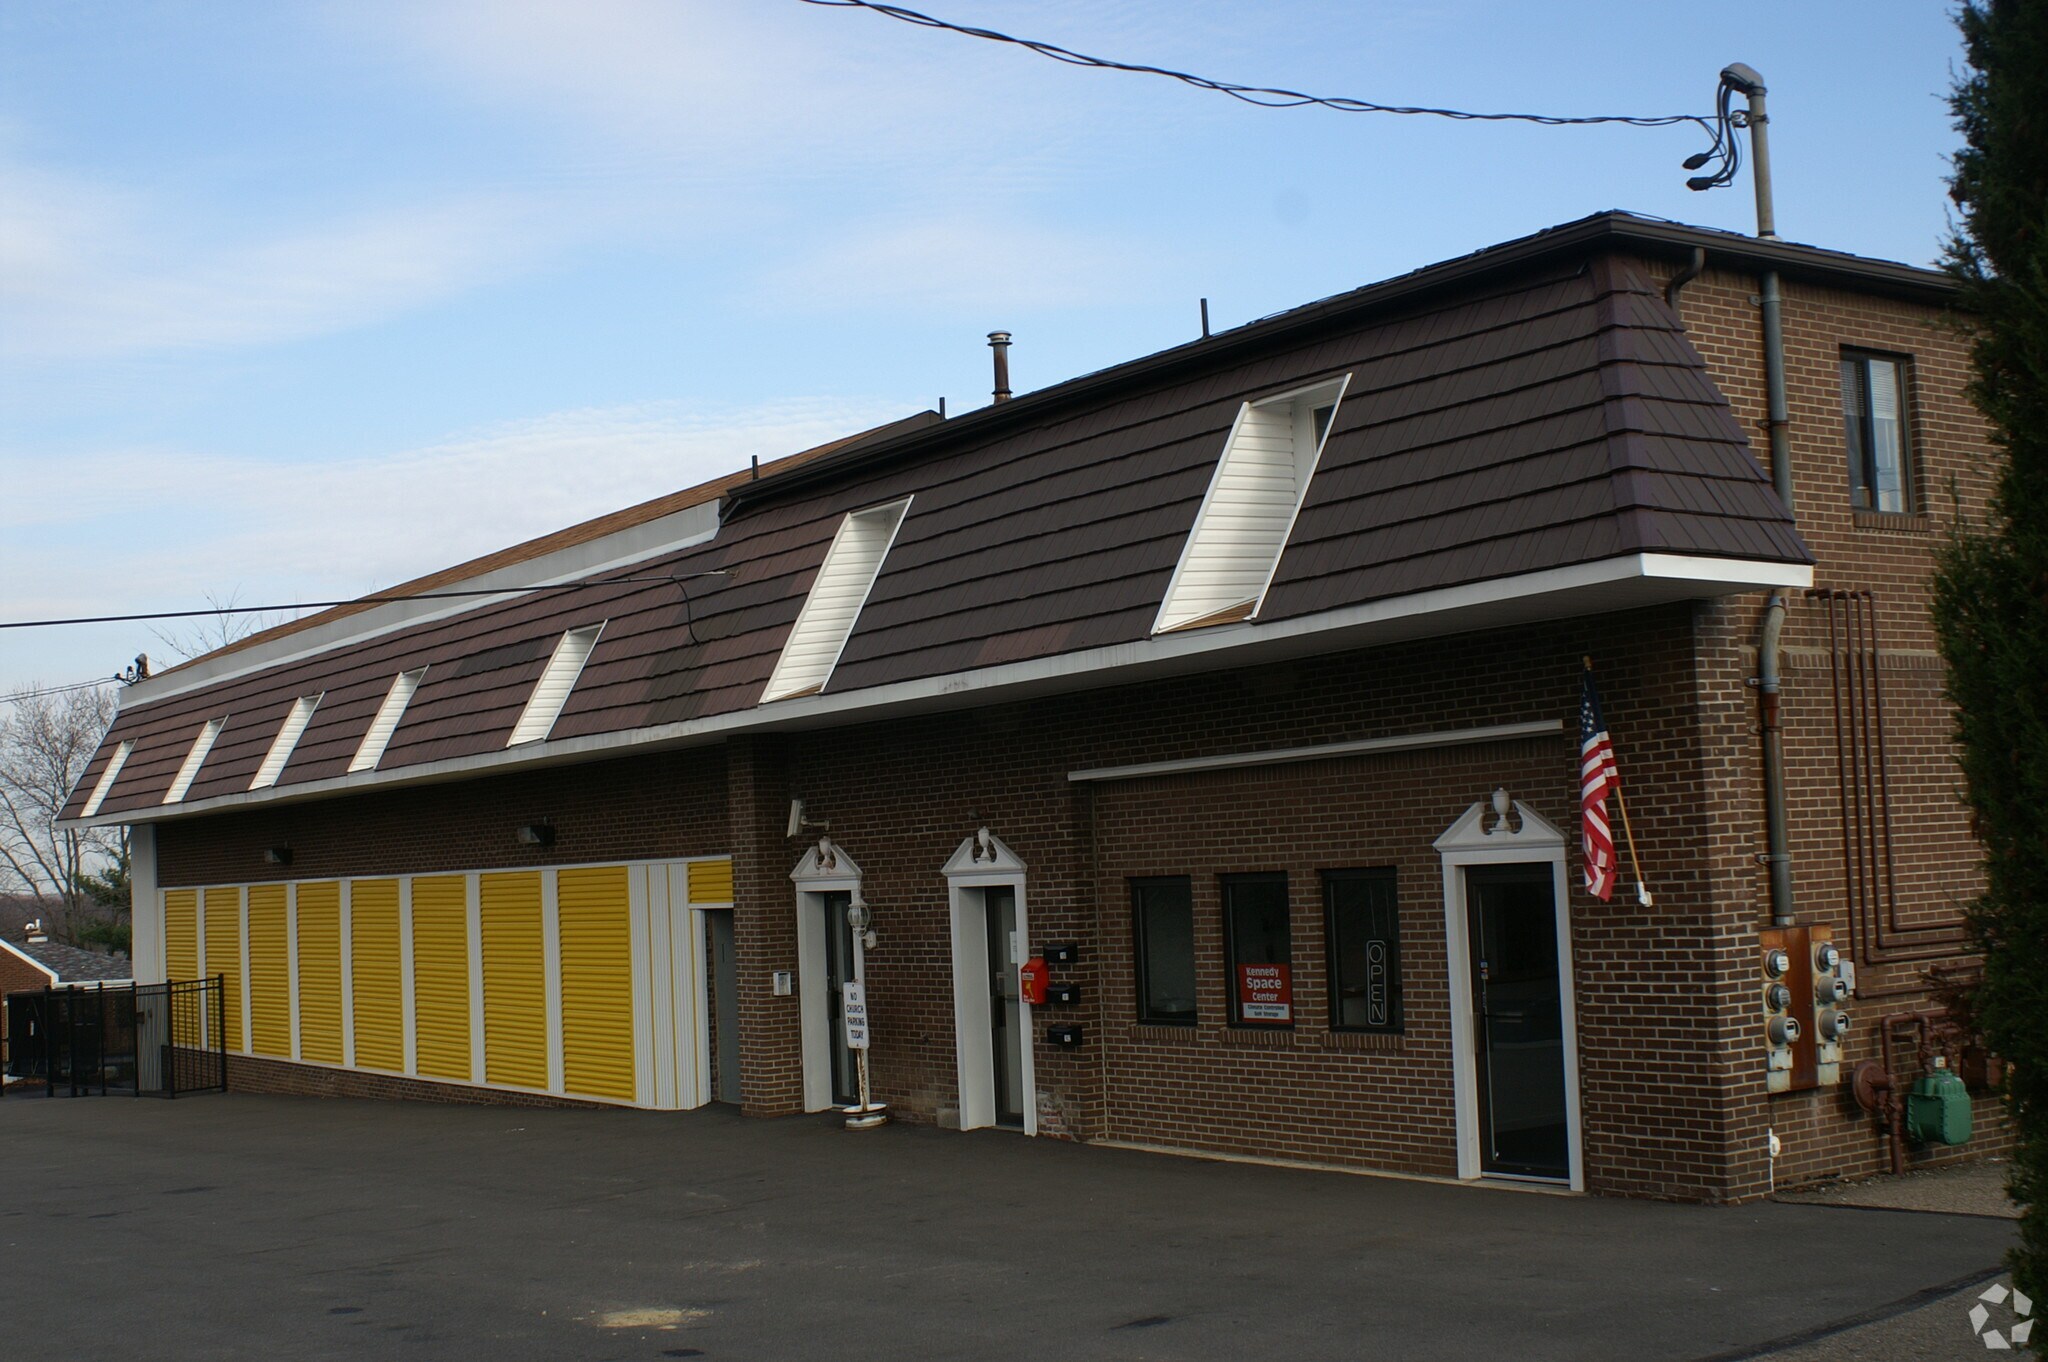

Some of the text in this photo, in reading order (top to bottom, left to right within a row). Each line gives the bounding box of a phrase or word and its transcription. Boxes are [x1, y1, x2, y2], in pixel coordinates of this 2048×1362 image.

[1246, 967, 1279, 978] Kennedy
[1246, 977, 1282, 990] Space
[1369, 944, 1384, 1021] OPEN
[850, 992, 857, 1001] NO
[1252, 992, 1278, 1001] Center
[847, 1004, 864, 1013] CHURCH
[847, 1017, 865, 1026] PARKING
[850, 1029, 864, 1039] TODAY
